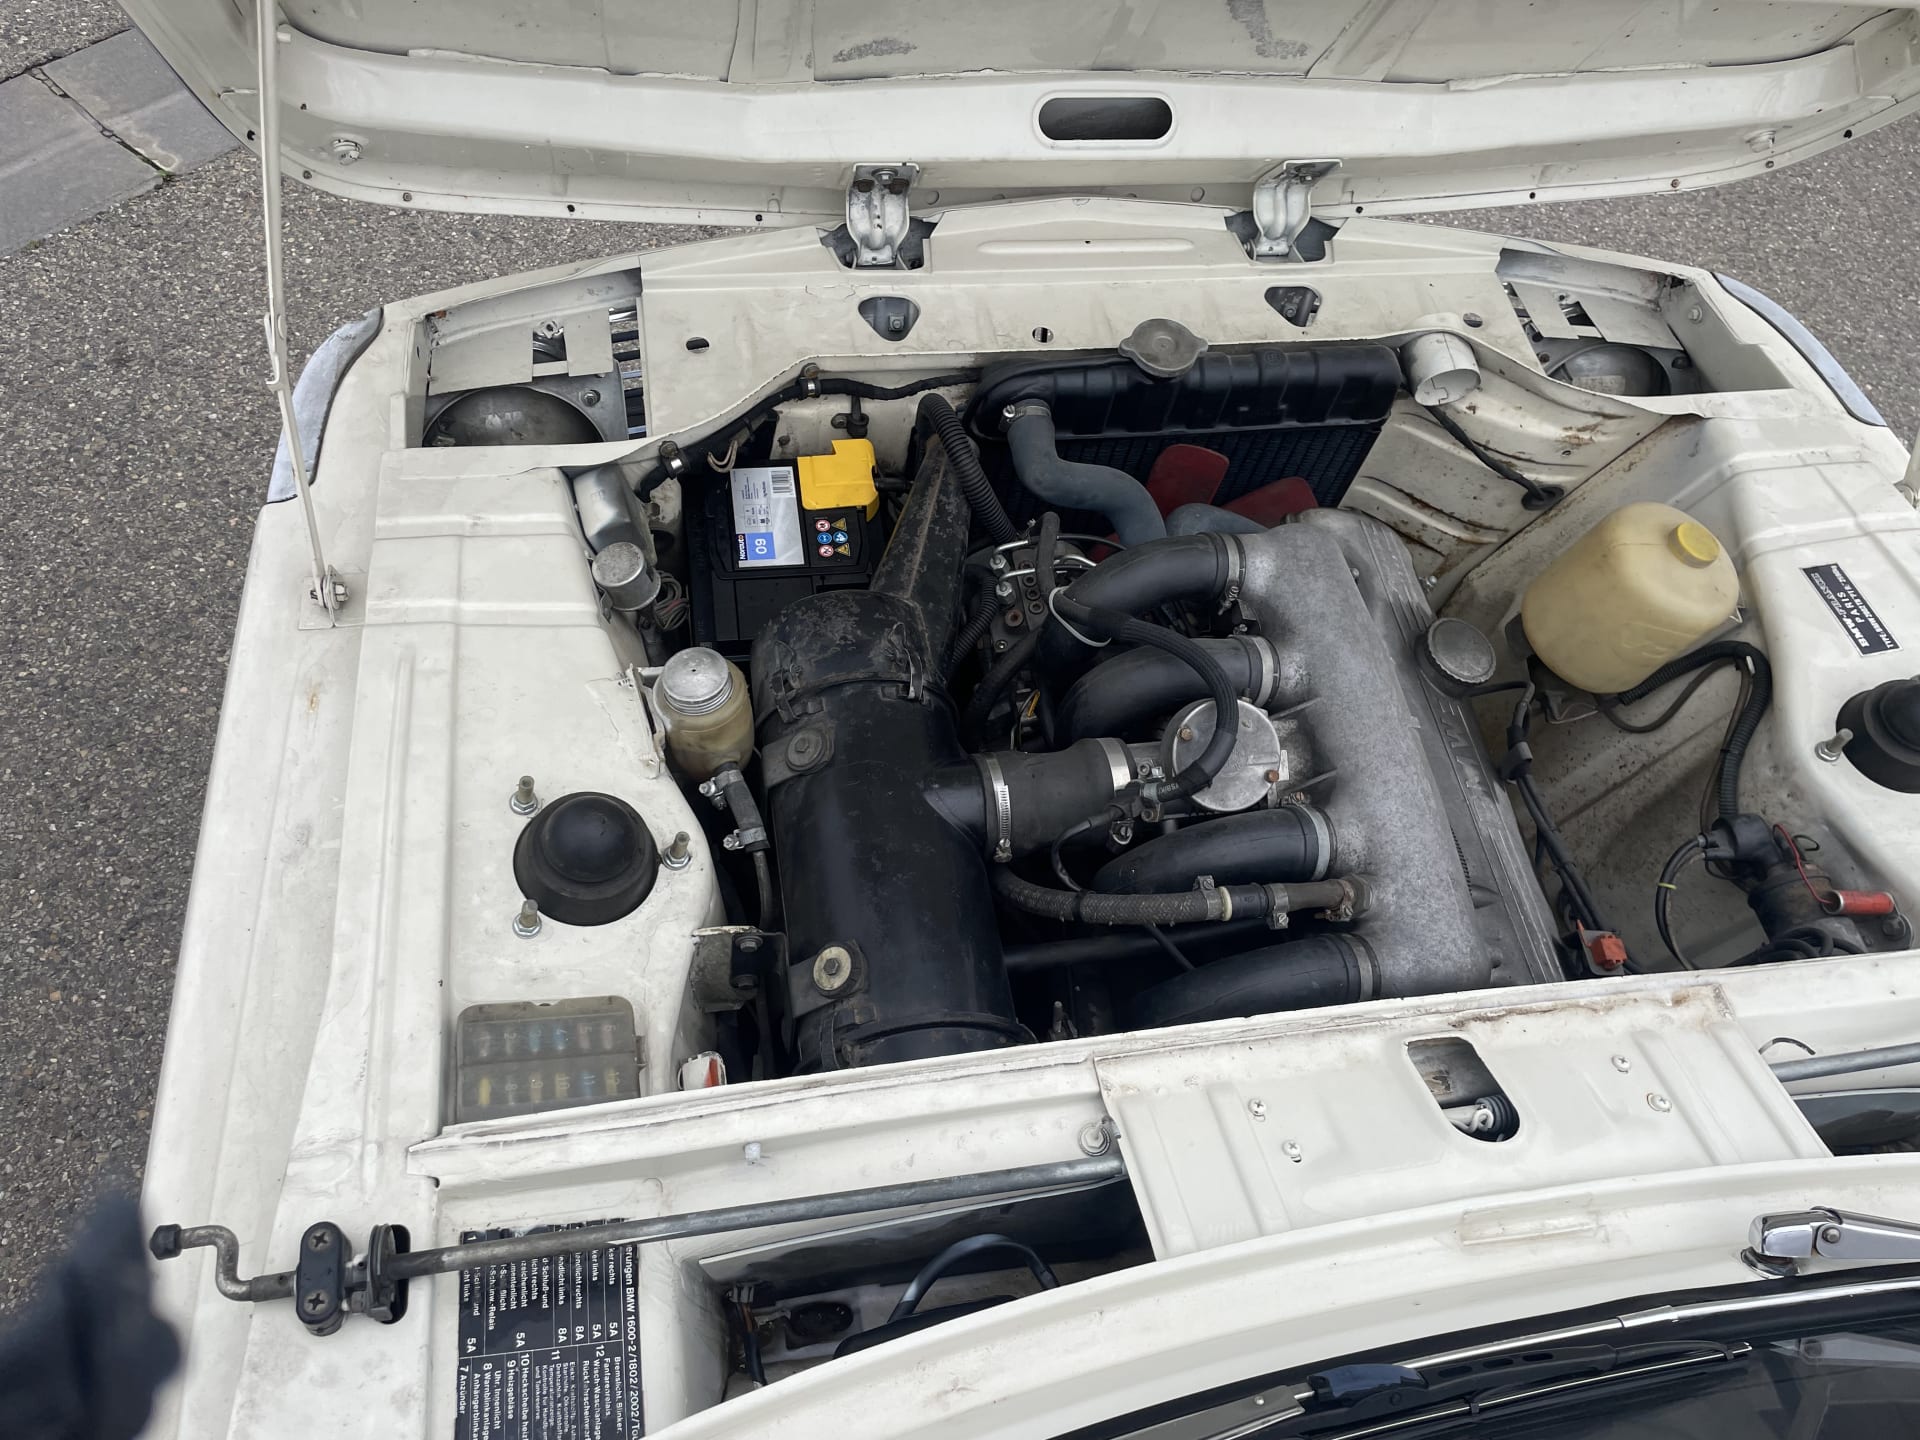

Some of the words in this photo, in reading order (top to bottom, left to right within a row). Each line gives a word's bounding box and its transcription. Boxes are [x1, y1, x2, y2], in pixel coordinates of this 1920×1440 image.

[738, 535, 746, 560] Norauto
[755, 538, 767, 554] 09
[1837, 591, 1864, 623] PARIS
[624, 1246, 633, 1284] erungen
[626, 1287, 635, 1312] BMW
[559, 1328, 567, 1343] 8A
[576, 1326, 584, 1341] 8A
[593, 1324, 601, 1339] 5A
[610, 1322, 618, 1337] 5A
[467, 1337, 476, 1353] 5A
[516, 1332, 525, 1347] 5A
[551, 1350, 560, 1360] 11
[596, 1345, 604, 1357] 12
[521, 1353, 529, 1366] 10
